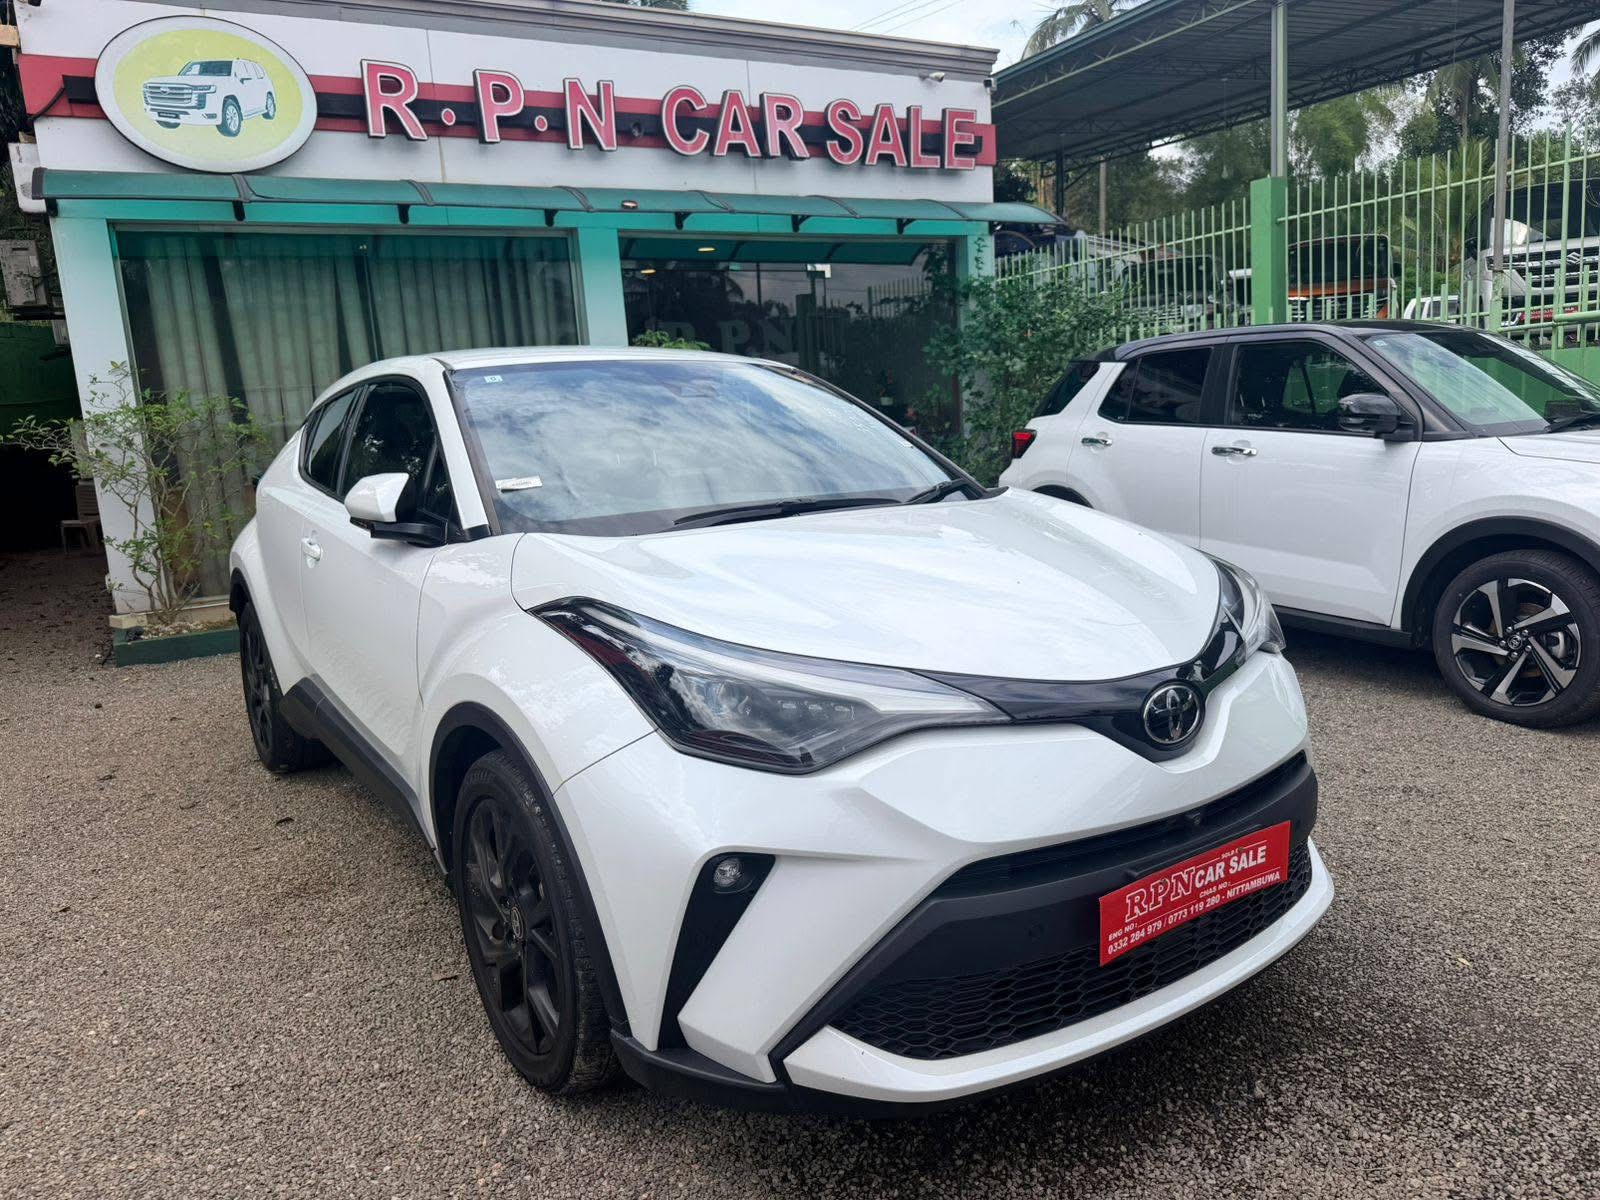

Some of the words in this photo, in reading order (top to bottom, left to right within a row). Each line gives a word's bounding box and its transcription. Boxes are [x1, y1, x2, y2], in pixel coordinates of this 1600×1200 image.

[660, 84, 811, 160] CAR
[824, 97, 978, 170] SALE
[1108, 928, 1123, 941] ENG
[1199, 885, 1217, 899] CHAS
[1108, 936, 1128, 955] 0332
[1130, 928, 1145, 943] 284
[1146, 920, 1163, 935] 979
[1168, 908, 1188, 924] 0773
[1190, 901, 1204, 914] 119
[1205, 894, 1221, 907] 280
[1226, 871, 1280, 899] NITTAMBUWA
[1125, 866, 1196, 923] RPN
[1194, 861, 1225, 888] CAR
[1229, 845, 1267, 874] SALE
